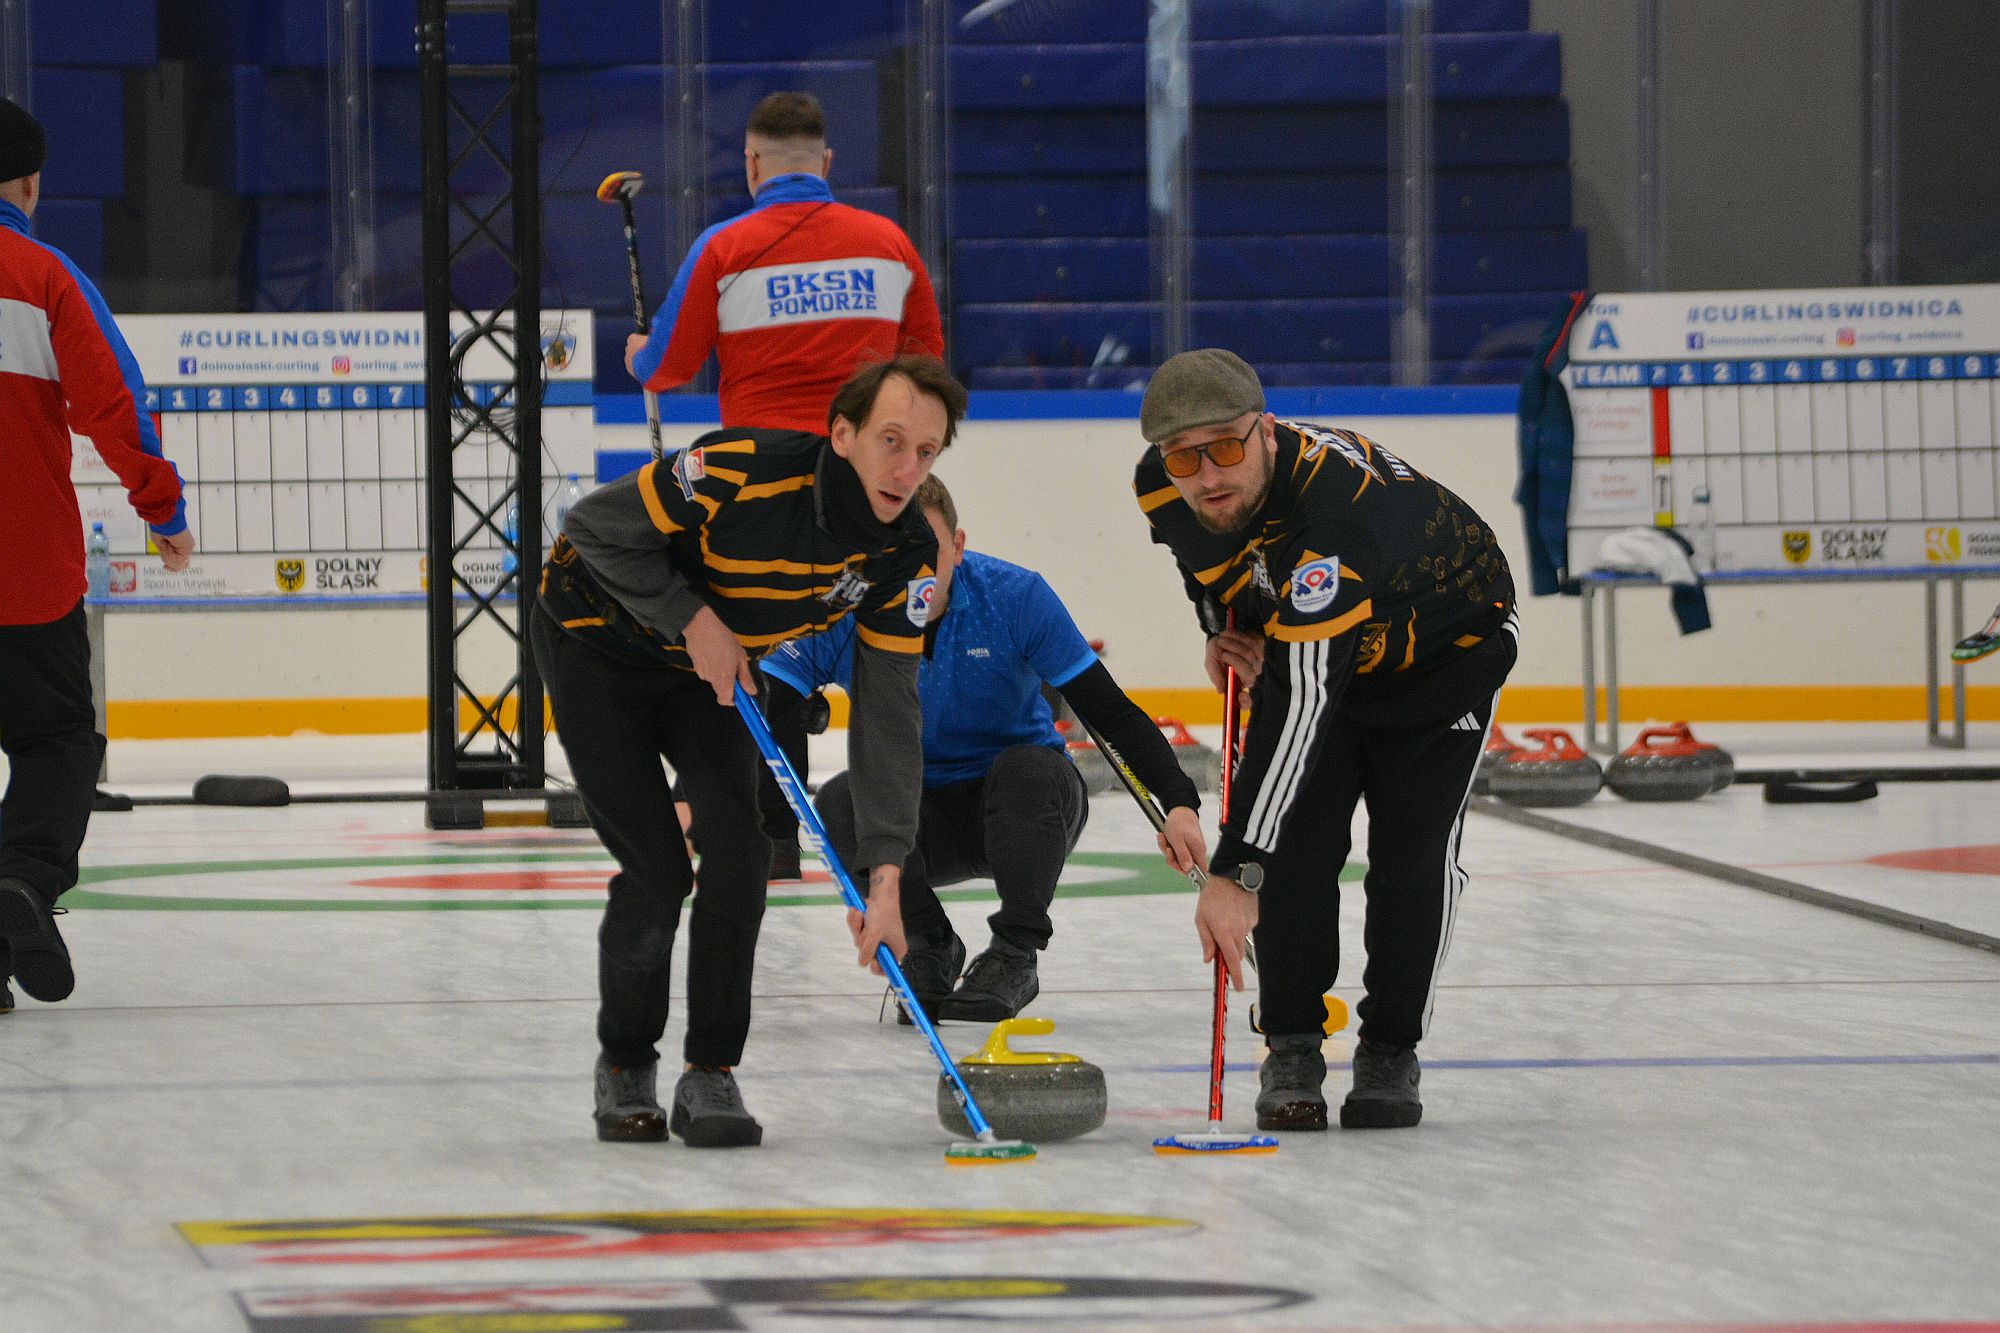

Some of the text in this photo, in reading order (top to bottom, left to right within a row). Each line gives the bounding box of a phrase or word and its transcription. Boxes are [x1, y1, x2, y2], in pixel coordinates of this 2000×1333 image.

[766, 269, 875, 300] GKSN
[769, 292, 877, 318] POMORZE
[1687, 299, 1962, 323] #CURLINGSWIDNICA
[1589, 320, 1620, 350] A
[1571, 366, 1639, 384] TEAM
[1679, 364, 1695, 383] 1
[1714, 363, 1730, 381] 2
[1749, 362, 1766, 380] 3
[1784, 361, 1801, 380] 4
[1892, 357, 1908, 377] 7
[172, 388, 186, 407] 1
[207, 388, 222, 407] 2
[244, 388, 259, 406] 3
[280, 387, 295, 406] 4
[317, 387, 331, 406] 5
[352, 387, 368, 405] 6
[388, 386, 403, 405] 7
[315, 558, 382, 572] DOLNY
